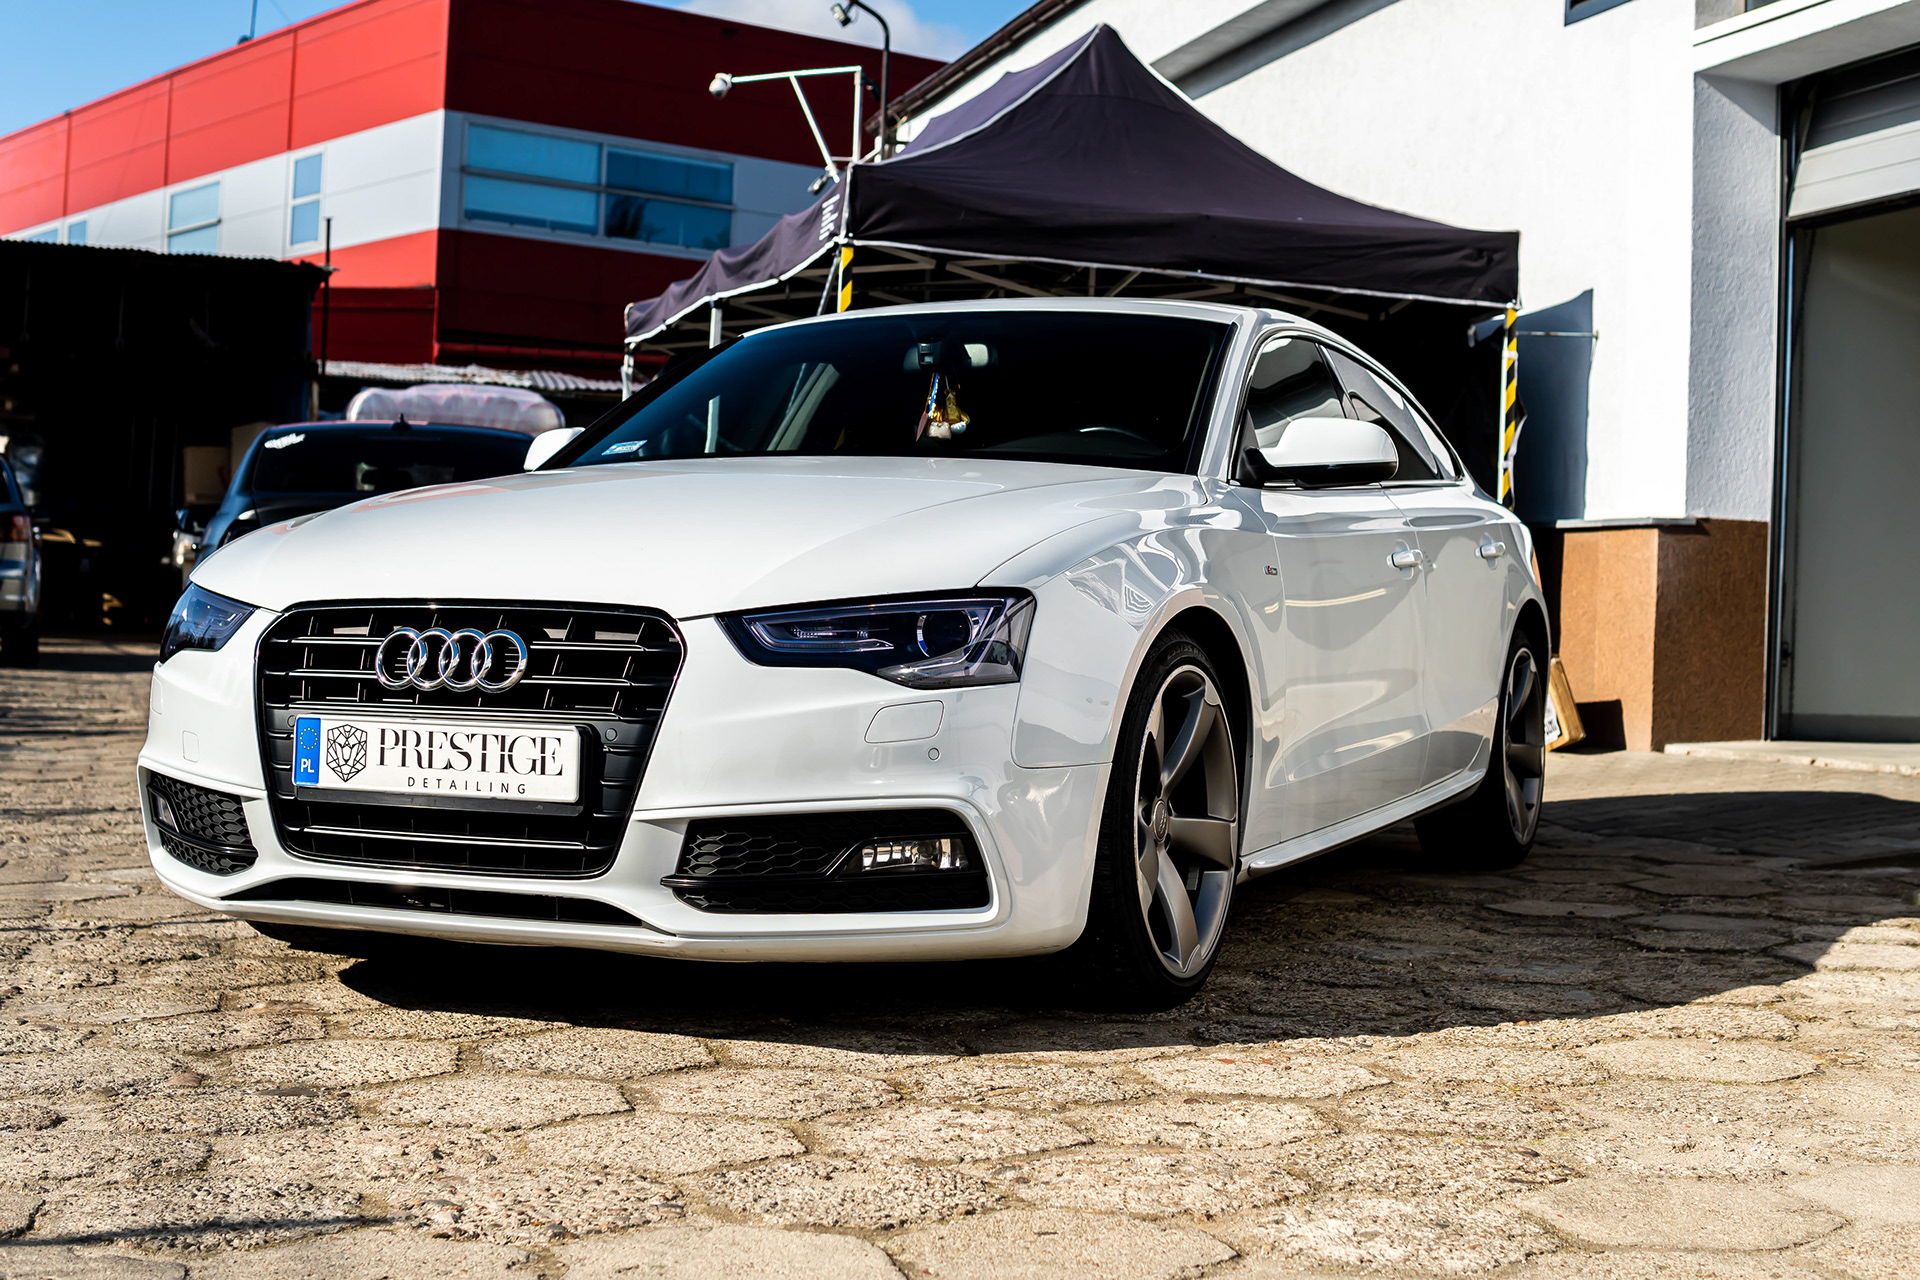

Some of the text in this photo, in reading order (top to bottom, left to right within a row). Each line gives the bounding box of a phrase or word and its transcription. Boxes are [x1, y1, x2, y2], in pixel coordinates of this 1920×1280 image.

[376, 727, 564, 776] PRESTIGE
[300, 758, 315, 774] PL
[407, 777, 527, 794] DETAILING
